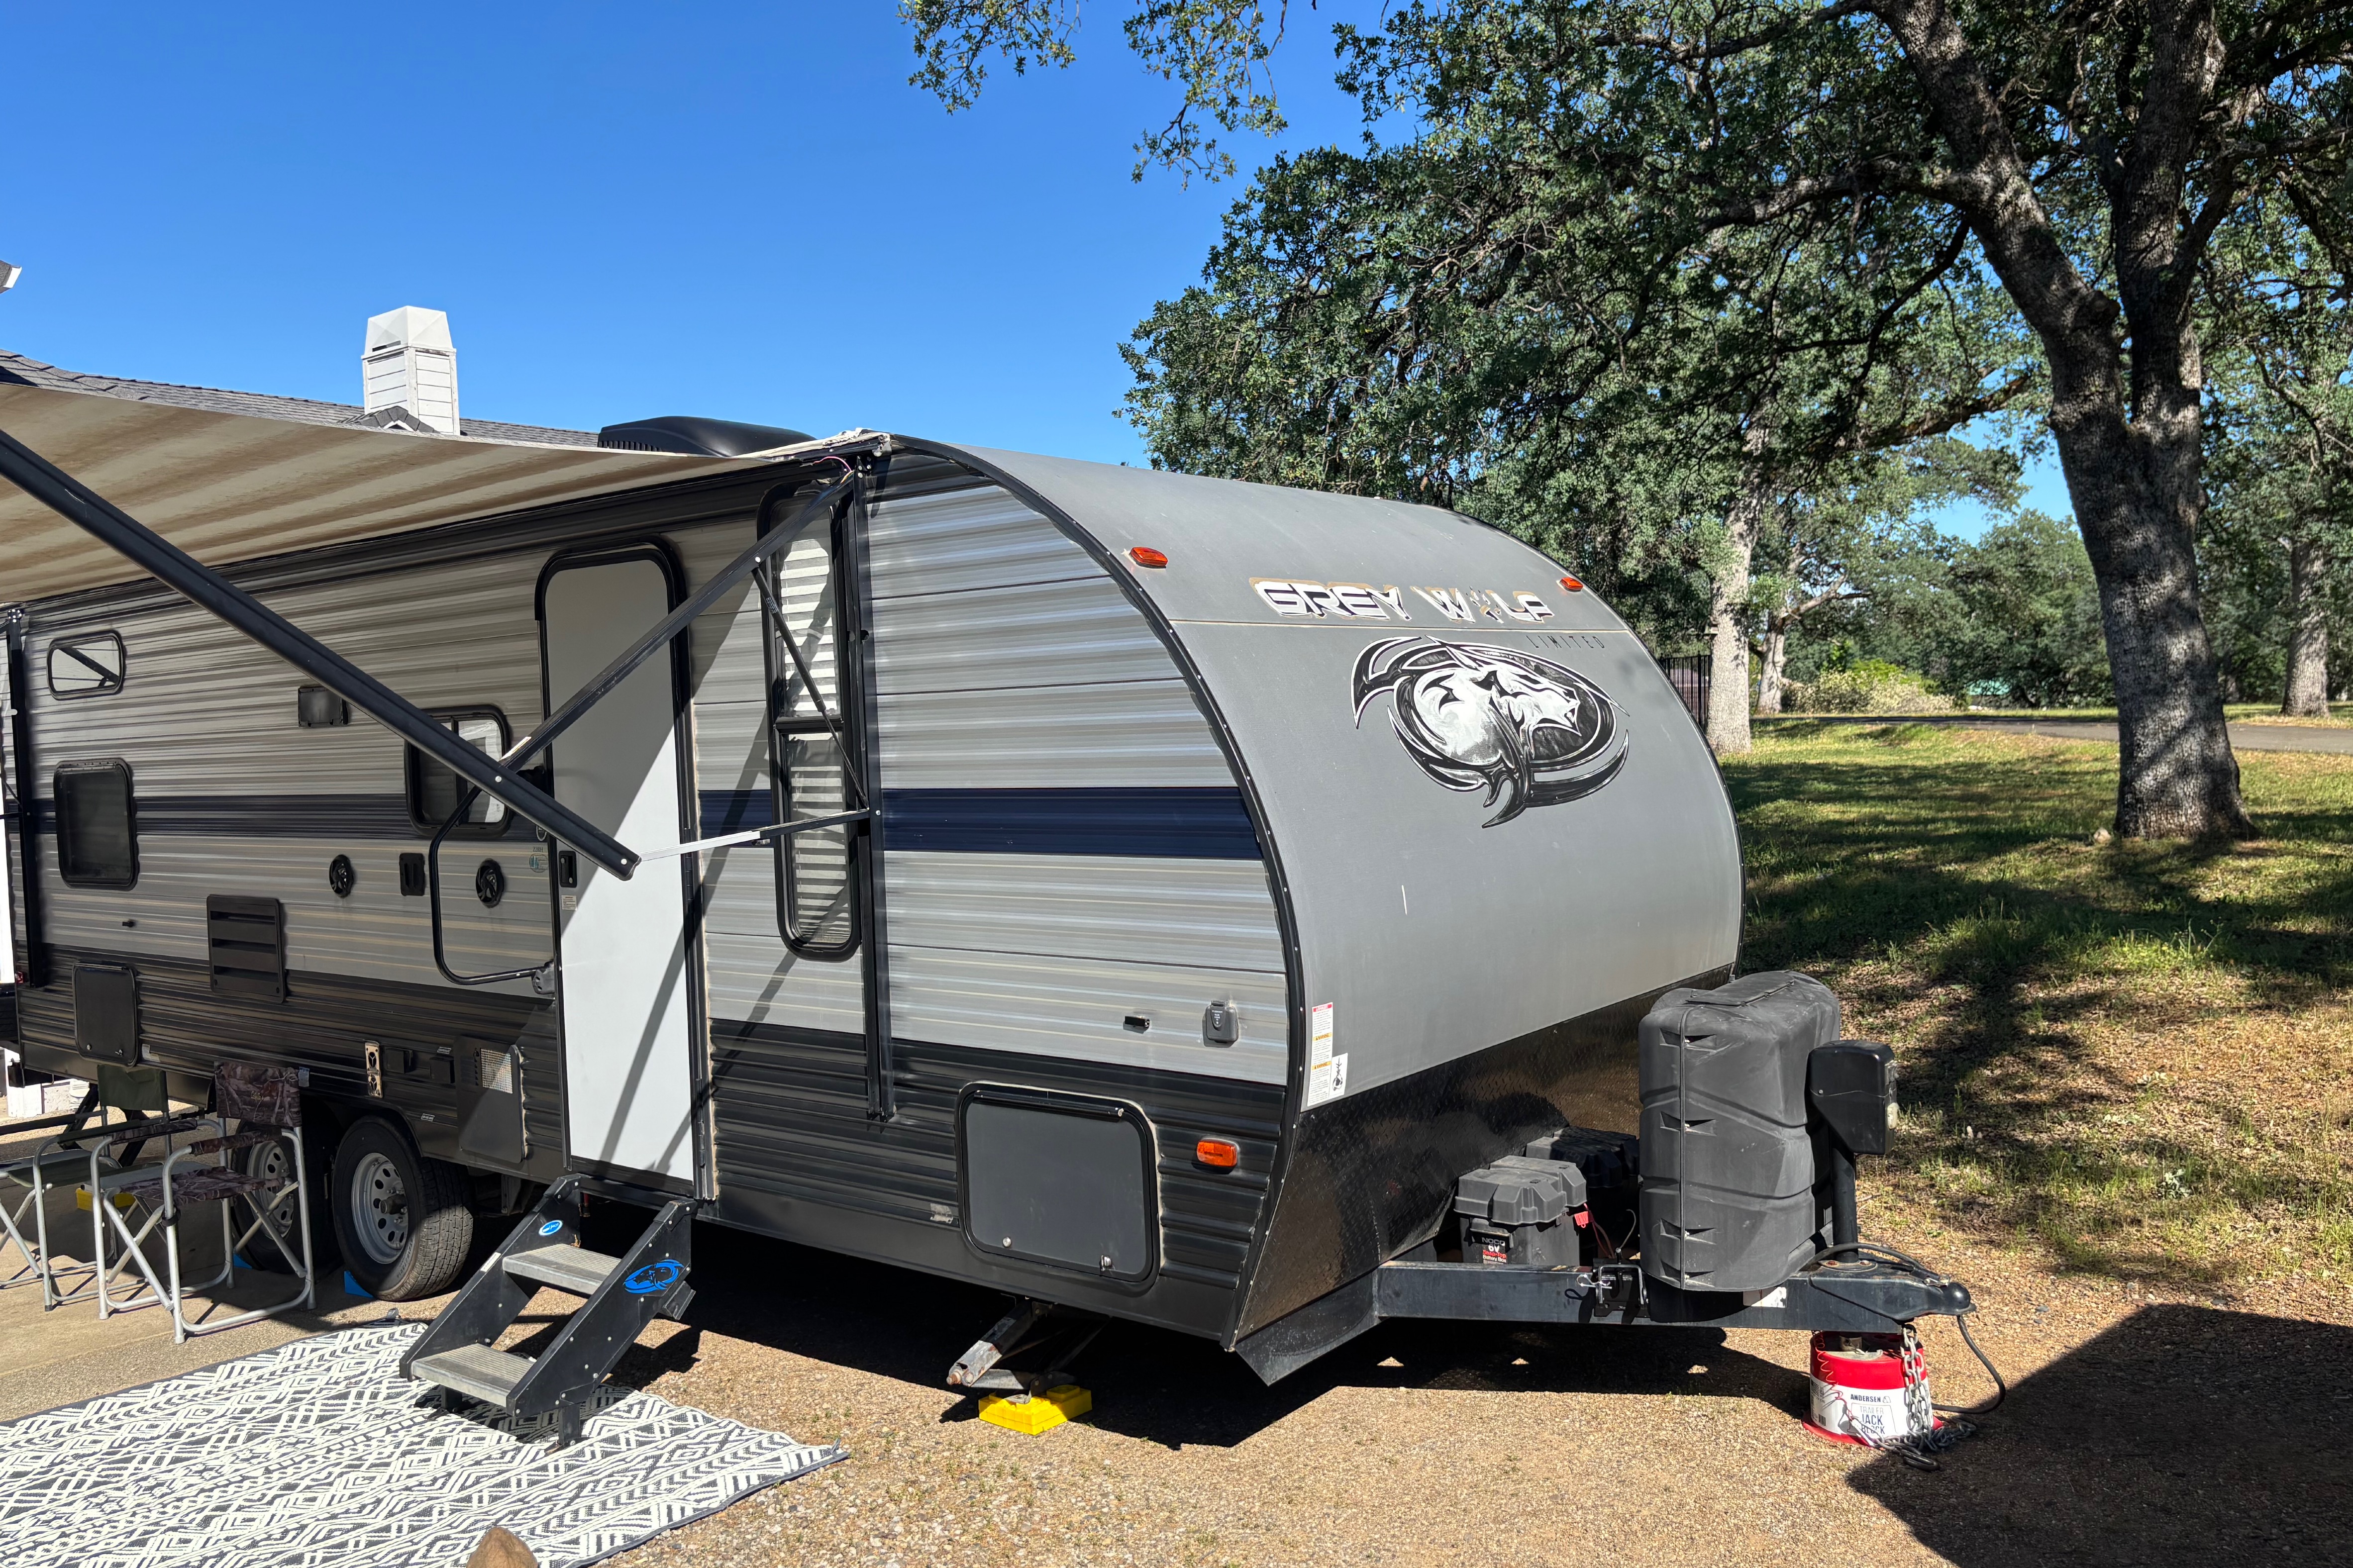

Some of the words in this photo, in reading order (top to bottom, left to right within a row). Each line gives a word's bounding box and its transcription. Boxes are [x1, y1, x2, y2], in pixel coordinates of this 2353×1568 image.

[1252, 580, 1412, 621] GREY
[1526, 635, 1605, 648] LIMITED
[1481, 1237, 1505, 1246] NOCO
[1488, 1244, 1500, 1253] 6V
[1850, 1394, 1881, 1402] ANDERSEN
[1861, 1414, 1883, 1425] JACK
